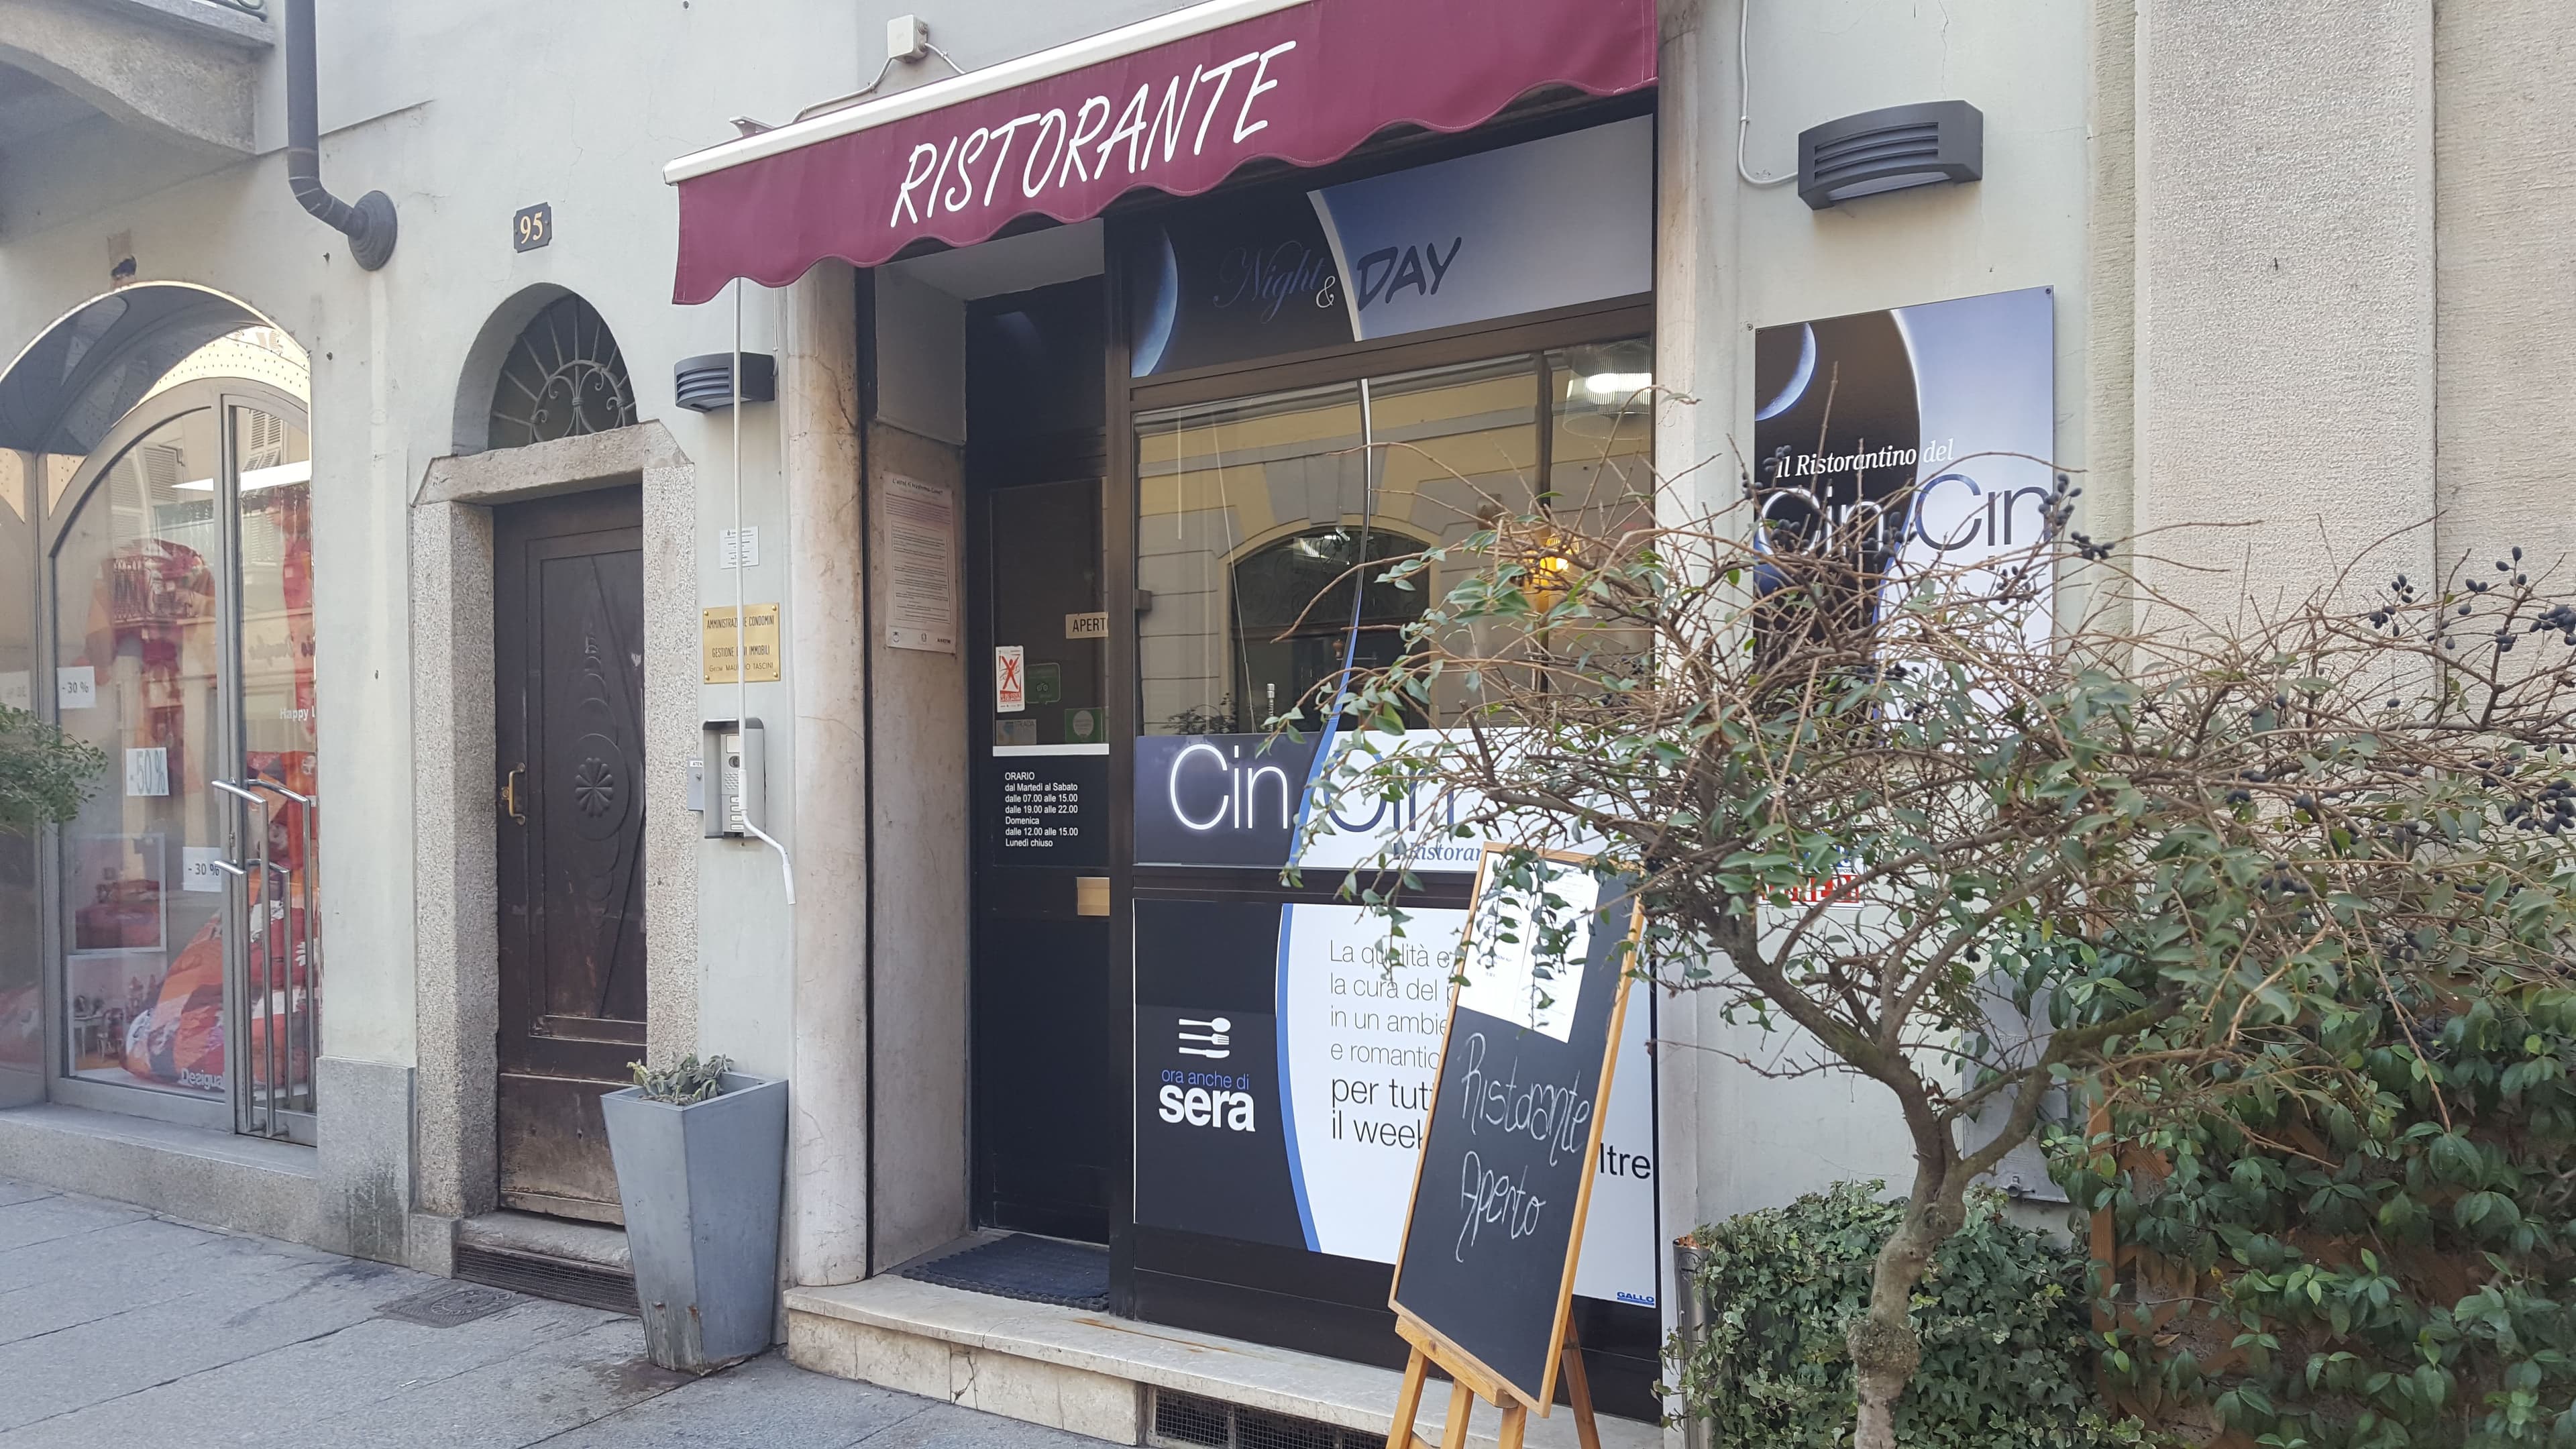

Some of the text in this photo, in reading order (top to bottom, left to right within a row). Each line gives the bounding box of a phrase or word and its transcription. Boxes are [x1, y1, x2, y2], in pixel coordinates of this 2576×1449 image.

[890, 40, 1296, 228] RISTORANTE
[520, 211, 543, 244] 95
[1213, 236, 1462, 324] Night & DAY
[1775, 437, 1955, 479] il Ristorantino del
[1915, 473, 2052, 570] Cin
[706, 615, 775, 629] AMMINISTRAZE CONDOMINI
[1072, 617, 1106, 633] APERT
[712, 646, 735, 658] GESTIONE
[749, 645, 771, 656] IMMOBILI
[725, 663, 751, 672] MAUIO
[68, 681, 78, 694] 30
[80, 681, 89, 693] %
[280, 707, 309, 722] Happy
[136, 749, 152, 794] 50
[155, 749, 166, 794] %
[1005, 771, 1035, 780] ORARIO
[1005, 783, 1016, 792] dal
[1044, 782, 1051, 791] al
[1053, 782, 1078, 791] Sabato
[1169, 743, 1289, 830] Cin
[1005, 794, 1078, 802] dalle 07.00 alle 15.00
[1005, 805, 1078, 814] dalle 19.00 alle 22.00
[1005, 816, 1040, 824] Domenica
[1005, 827, 1079, 836] dalle 12.00 alle 15.00
[1030, 839, 1053, 847] chiuso
[195, 863, 207, 875] 30
[209, 863, 220, 876] %
[1330, 938, 1450, 969] La qulità e
[1330, 972, 1346, 996] la
[1353, 979, 1399, 999] cura
[1406, 977, 1438, 1002] del
[1331, 1004, 1346, 1028] in
[1354, 1012, 1379, 1031] un
[1330, 1043, 1343, 1061] e
[1161, 1069, 1249, 1090] ora anche di
[1332, 1078, 1435, 1111] per tut
[1159, 1084, 1256, 1132] sera
[1332, 1109, 1342, 1140] il
[1455, 1150, 1546, 1263] Aperto
[1617, 1291, 1655, 1303] GALLO
